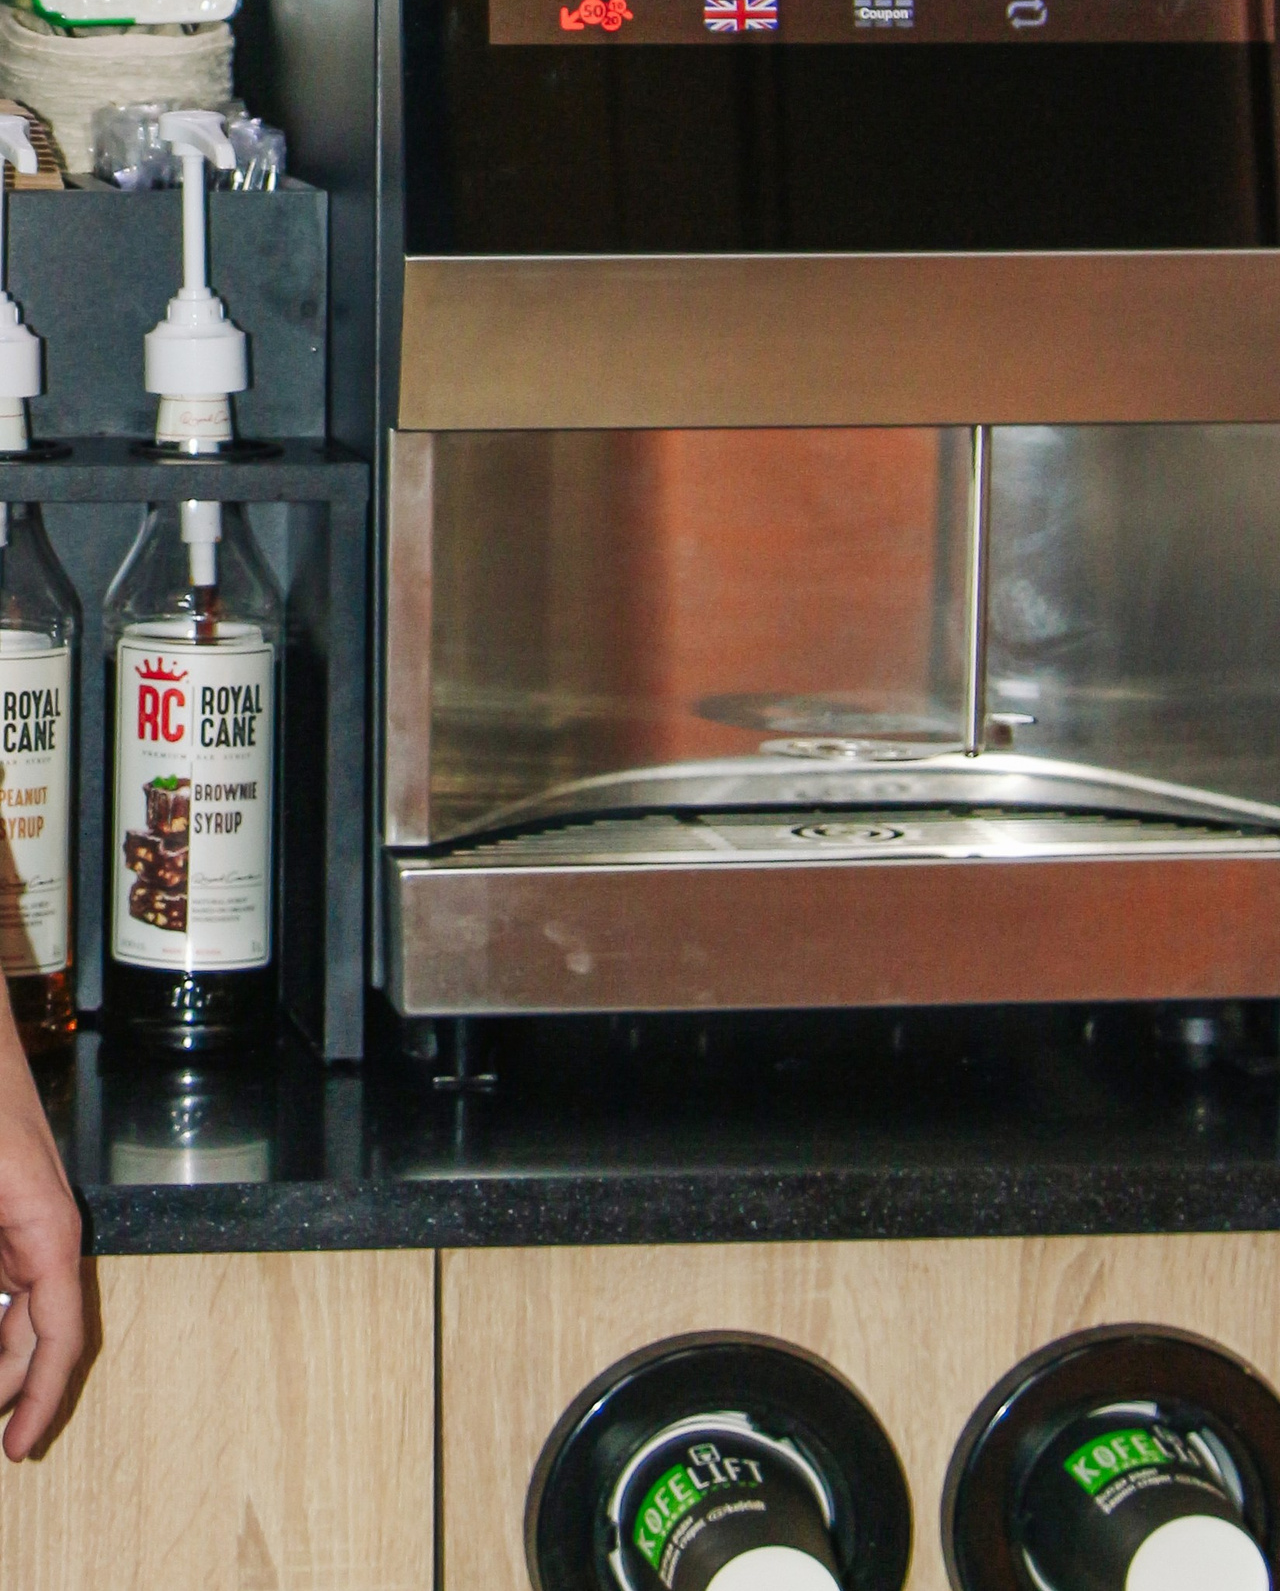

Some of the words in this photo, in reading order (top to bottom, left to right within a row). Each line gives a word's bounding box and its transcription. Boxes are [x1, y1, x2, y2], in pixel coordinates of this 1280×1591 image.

[582, 4, 603, 18] 50
[860, 7, 909, 22] Coupon
[3, 688, 61, 721] ROYAL
[138, 684, 185, 743] RC
[201, 683, 263, 716] ROYAL
[3, 719, 56, 753] CANE
[200, 714, 257, 749] CANE
[194, 781, 258, 801] BROWNIE
[194, 811, 243, 834] SYRUP
[637, 1457, 764, 1558] KOFELIFT
